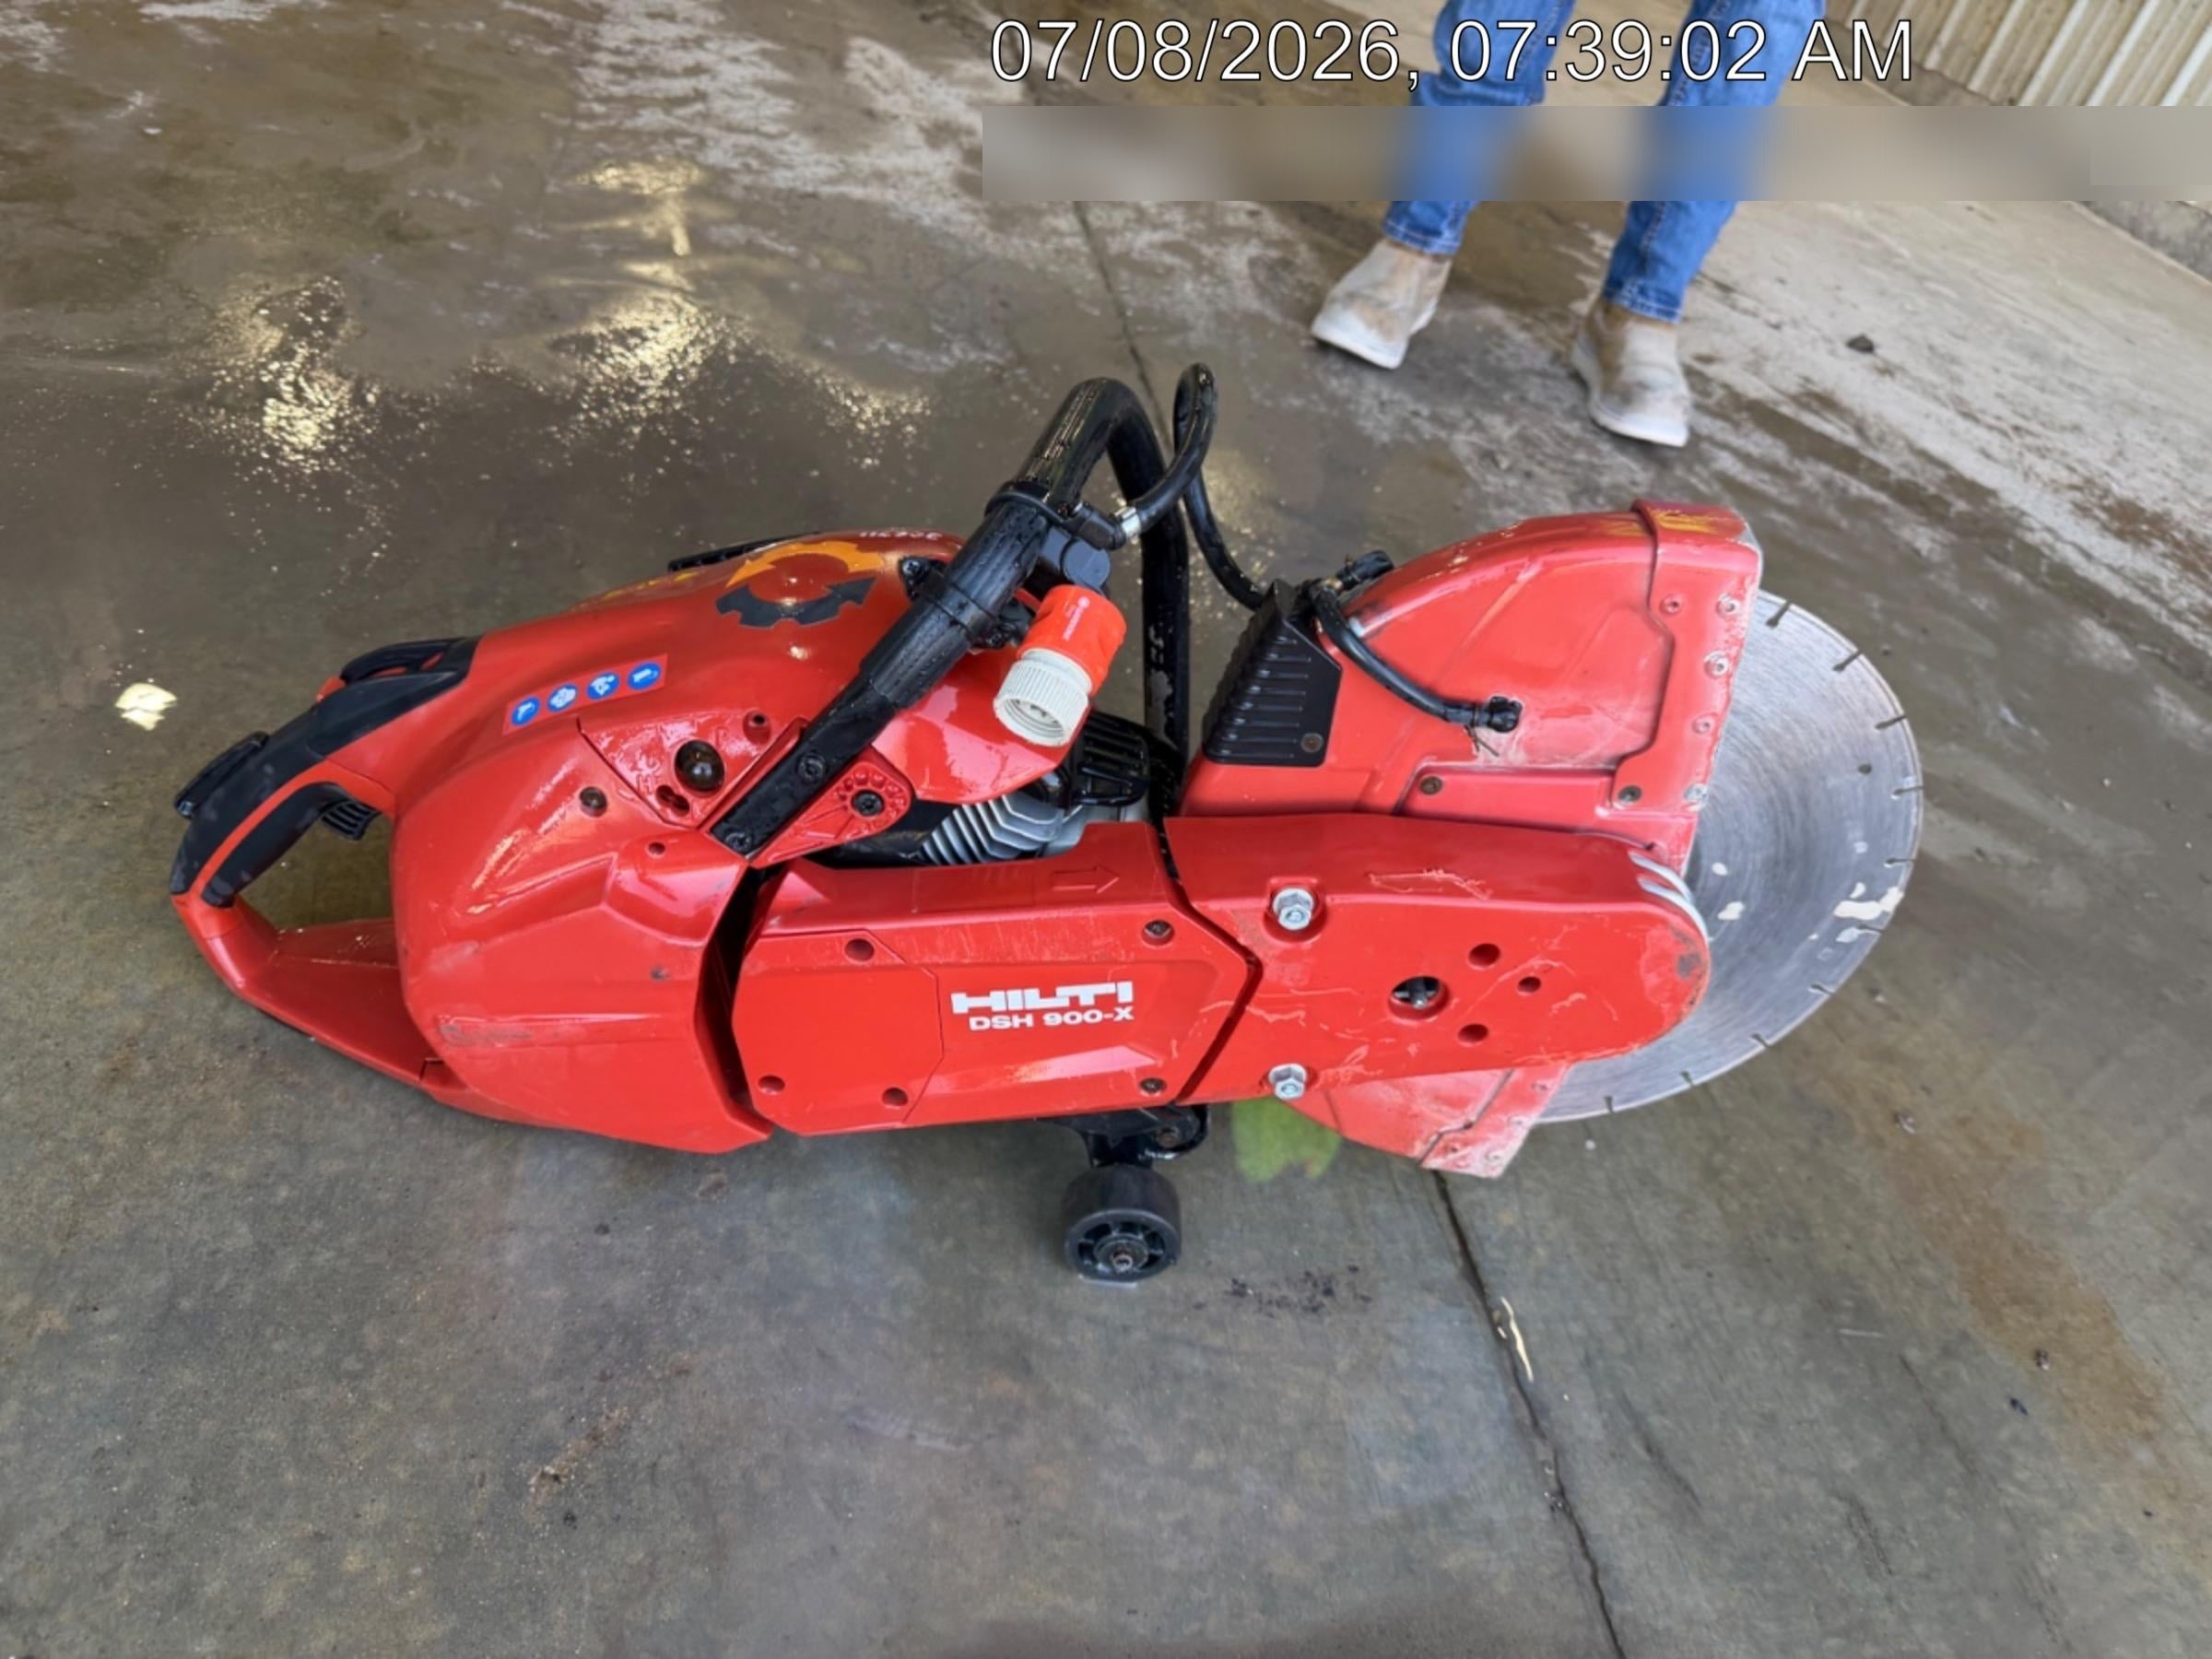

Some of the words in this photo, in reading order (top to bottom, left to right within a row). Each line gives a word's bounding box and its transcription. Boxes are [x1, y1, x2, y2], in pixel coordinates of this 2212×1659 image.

[950, 981, 1134, 1014] HILTI
[969, 1015, 1034, 1030] DSH
[1042, 1006, 1134, 1026] 900-X
